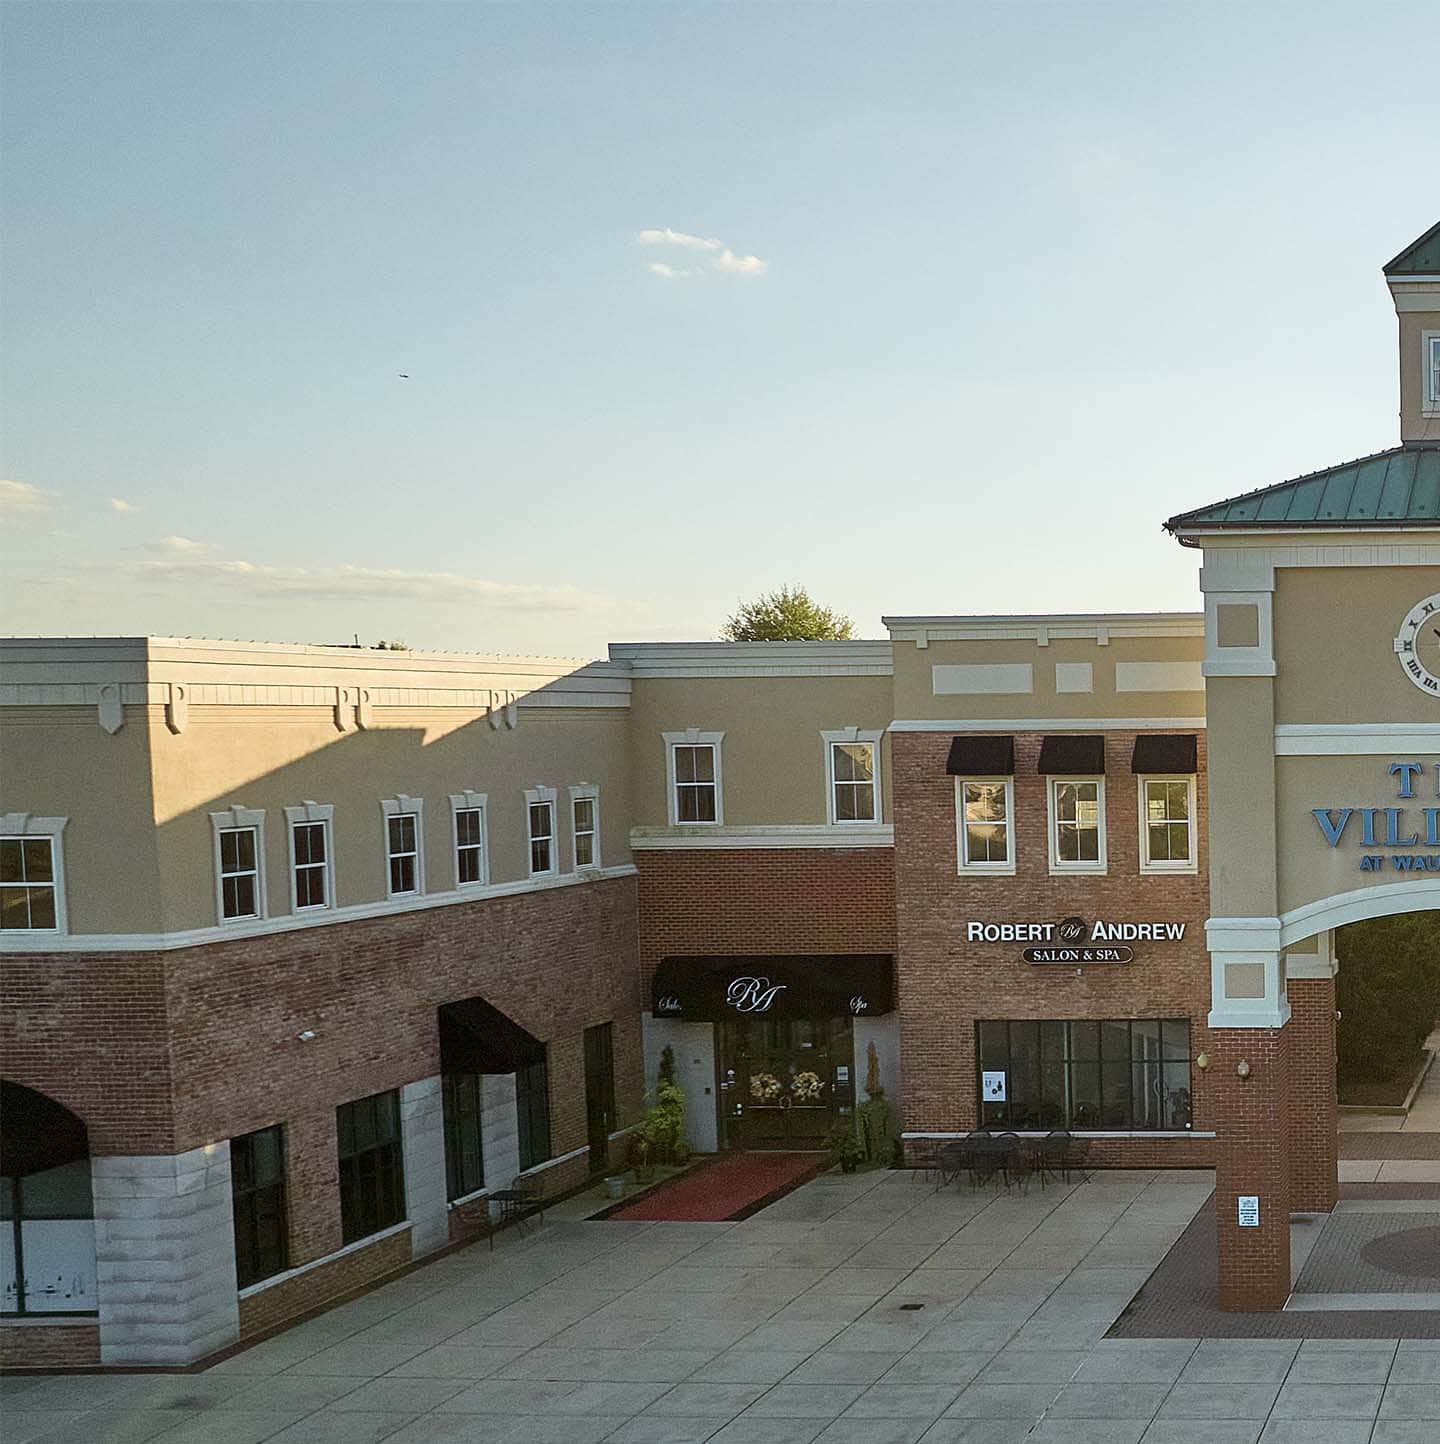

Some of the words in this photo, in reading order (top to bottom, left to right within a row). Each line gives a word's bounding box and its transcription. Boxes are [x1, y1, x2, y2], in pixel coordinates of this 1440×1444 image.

[1422, 603, 1435, 615] XI
[1408, 620, 1419, 629] X
[1404, 640, 1412, 651] IX
[1407, 660, 1422, 679] VIII
[1423, 678, 1438, 690] VII
[1360, 855, 1385, 871] AT
[967, 921, 1054, 942] ROBERT
[1091, 921, 1186, 942] ANDREW
[1033, 950, 1079, 961] SALON
[1083, 951, 1093, 961] &
[1096, 950, 1120, 961] SPA
